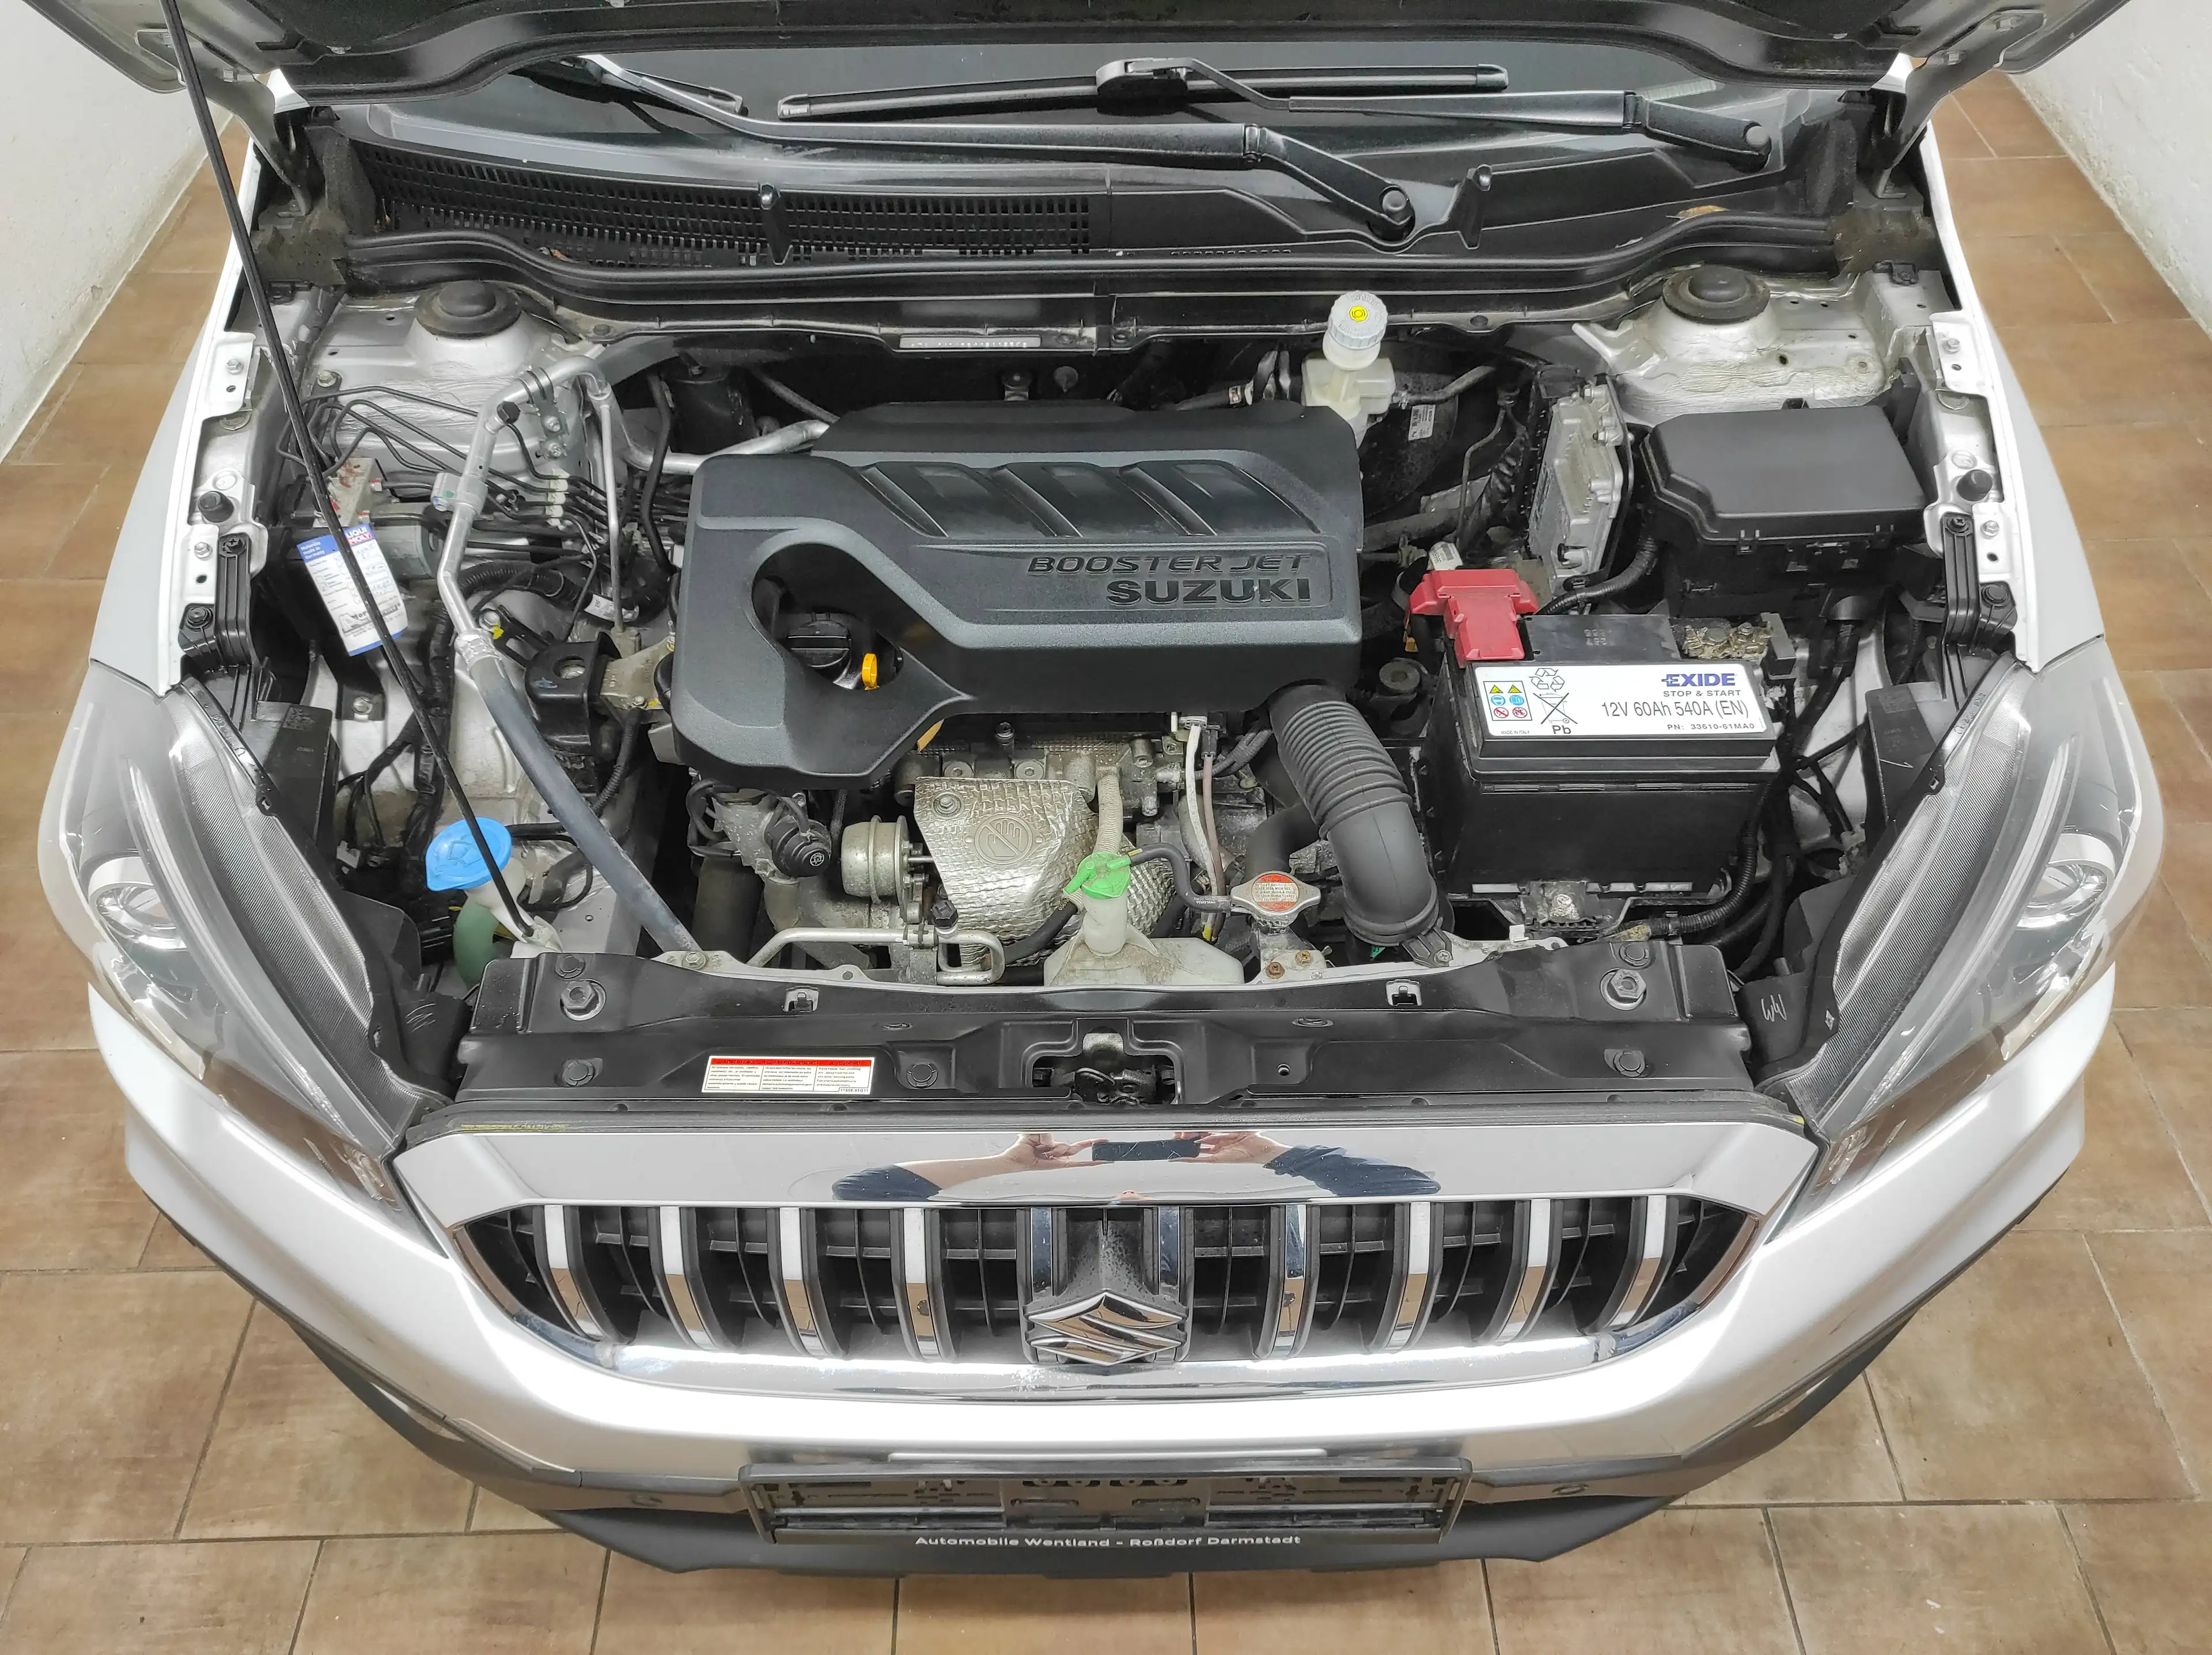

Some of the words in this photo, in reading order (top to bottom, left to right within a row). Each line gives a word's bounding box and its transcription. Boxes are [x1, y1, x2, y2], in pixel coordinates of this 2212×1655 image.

[1106, 578, 1311, 605] SUZUKI
[1661, 673, 1736, 687] EXIDE
[1602, 702, 1627, 717] 12V
[1634, 701, 1671, 716] 60Ah
[1675, 700, 1714, 716] 540A
[1715, 700, 1748, 719] (EN)
[1552, 725, 1571, 734] Pb
[915, 1537, 1019, 1546] Automobile
[1024, 1537, 1109, 1546] Wentland
[1130, 1536, 1202, 1546] Roßdorf
[1207, 1536, 1301, 1544] Darmstadt
